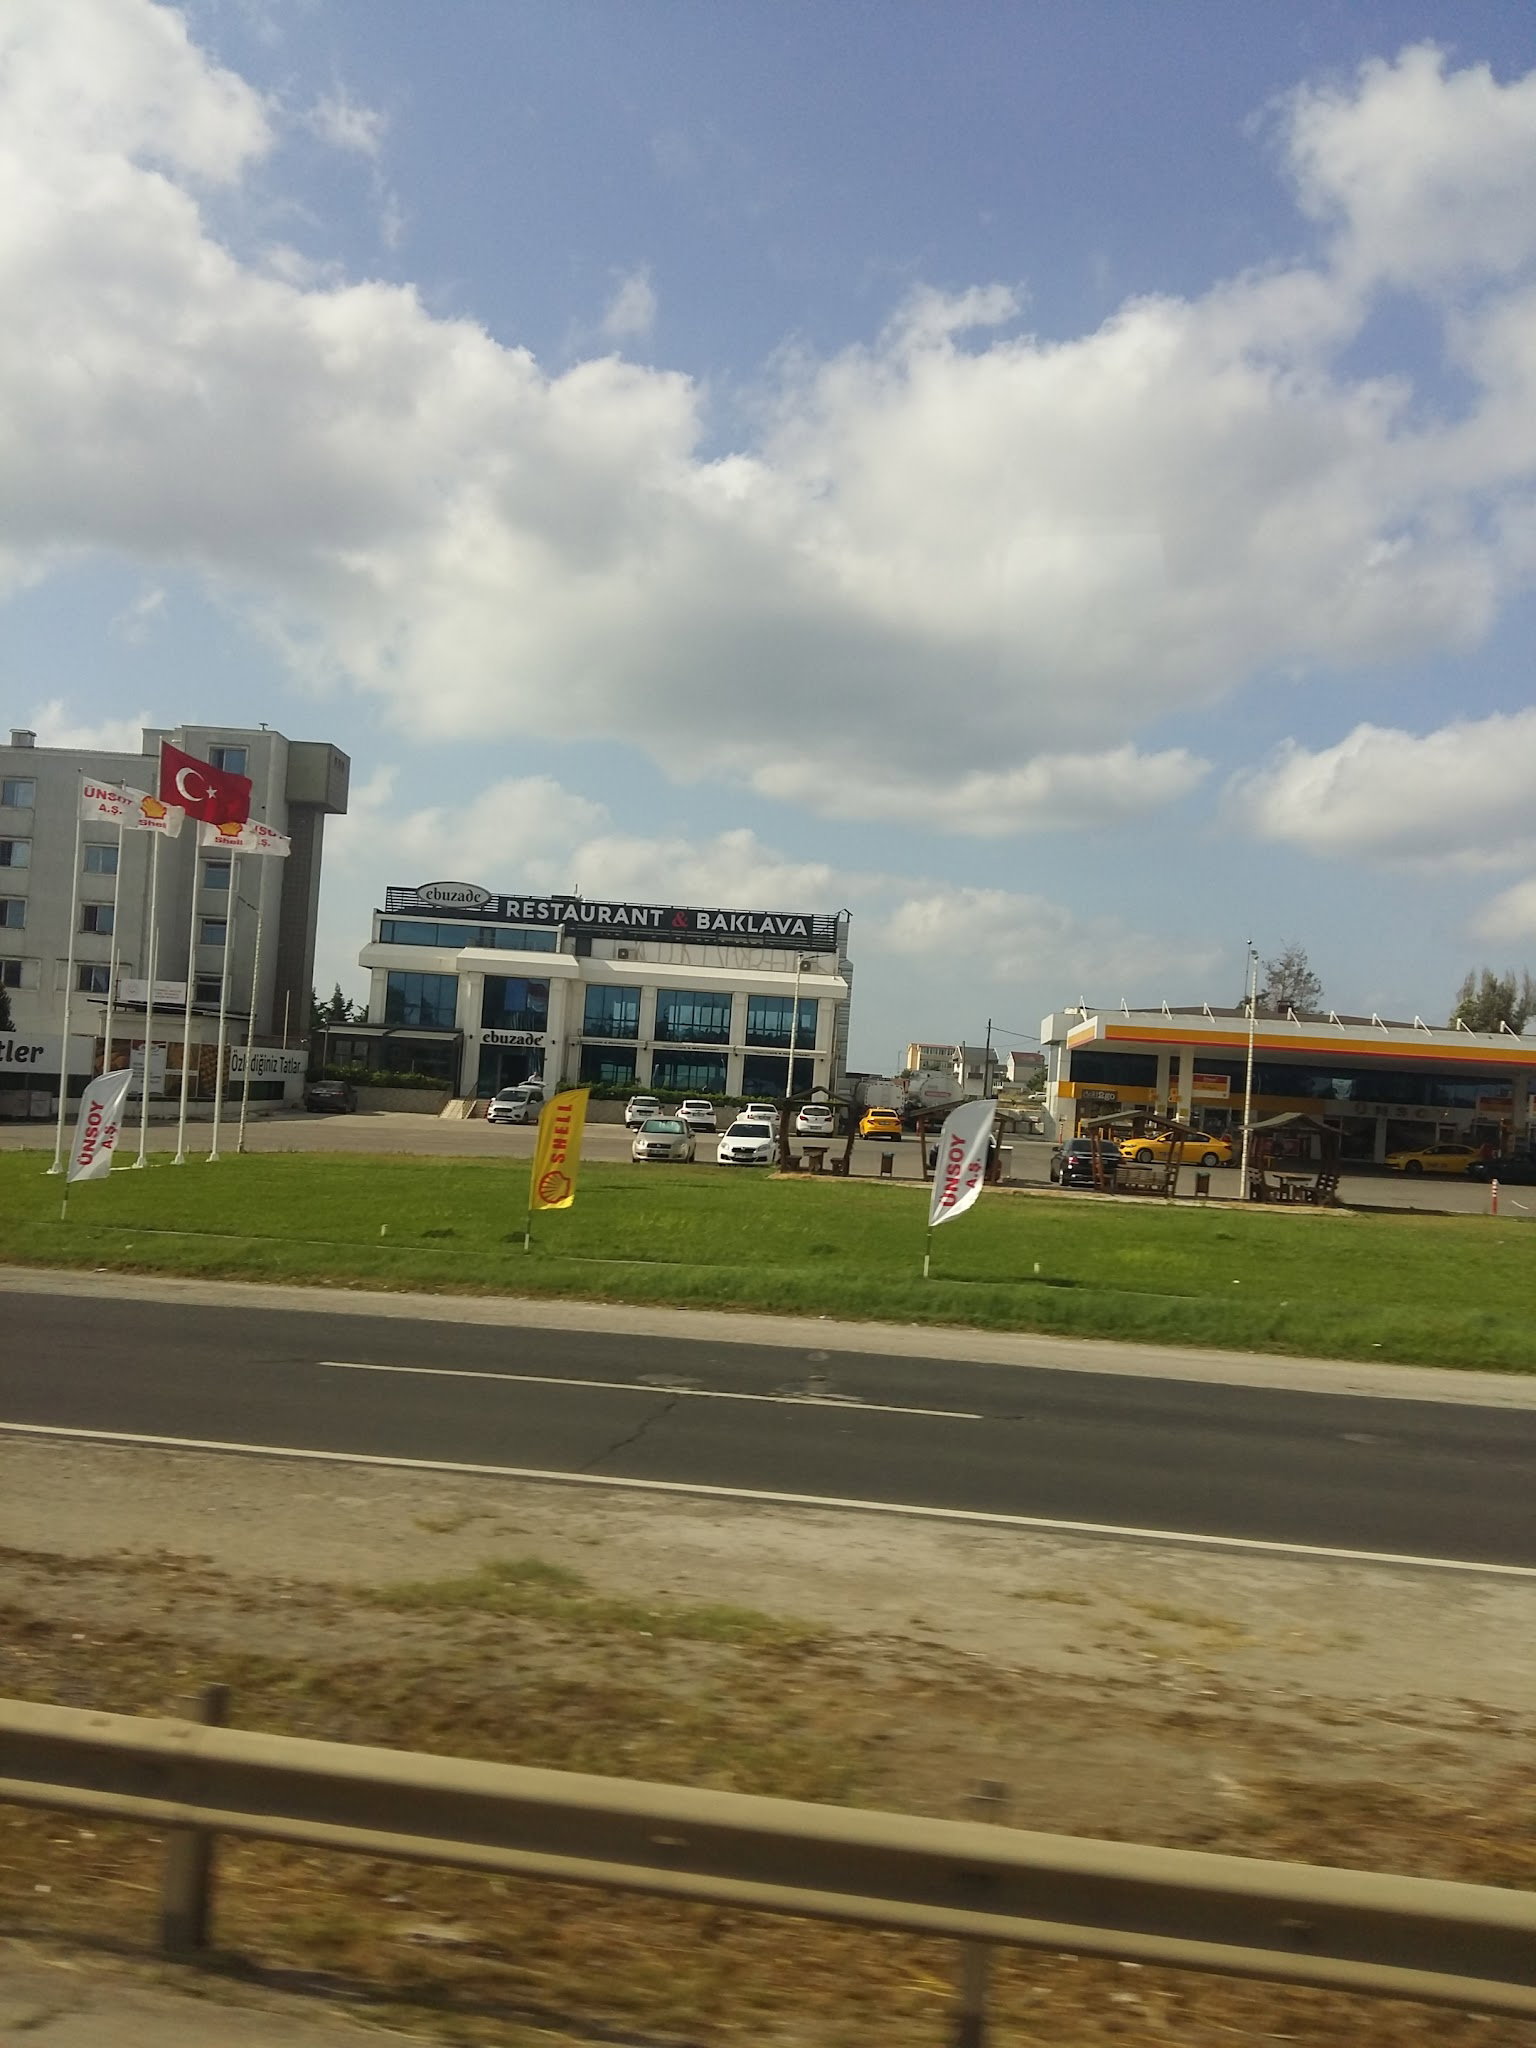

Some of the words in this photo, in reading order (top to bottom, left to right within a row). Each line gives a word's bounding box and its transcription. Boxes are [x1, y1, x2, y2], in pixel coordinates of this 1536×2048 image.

[425, 888, 481, 903] ebuzade
[506, 901, 664, 927] RESTAURANT
[671, 911, 688, 928] &
[696, 912, 807, 936] BAKLAVA
[482, 1030, 542, 1046] ebuzade
[231, 1049, 278, 1076] Özldiğiniz
[76, 1100, 104, 1166] ÜNSOY
[551, 1104, 573, 1163] SHELL
[939, 1133, 966, 1207] ÜNSOY
